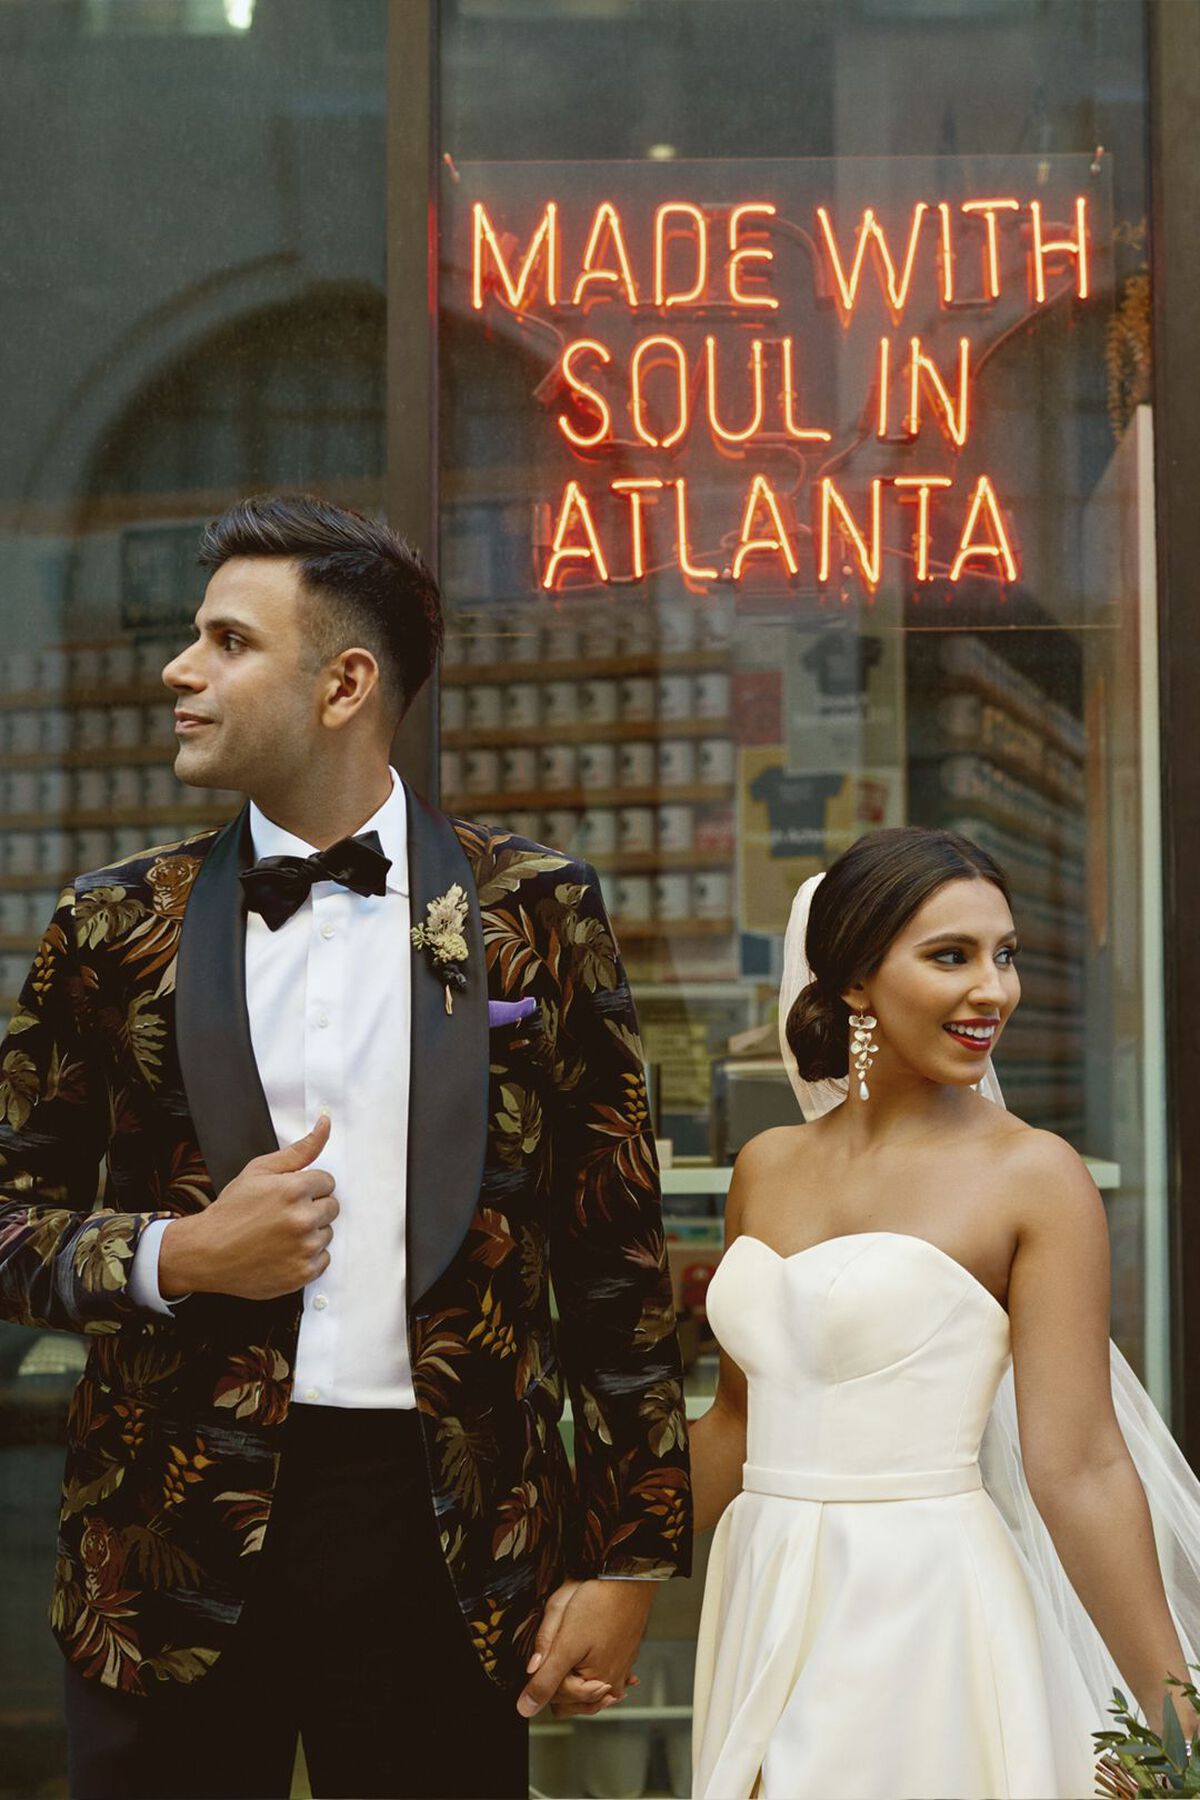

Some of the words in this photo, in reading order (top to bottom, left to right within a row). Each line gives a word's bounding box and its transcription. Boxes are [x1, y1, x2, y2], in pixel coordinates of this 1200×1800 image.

[472, 201, 779, 311] MADE
[816, 196, 1090, 311] WITH
[557, 334, 832, 449] SOUL
[877, 336, 970, 447] IN
[543, 473, 1019, 590] ATLANTA
